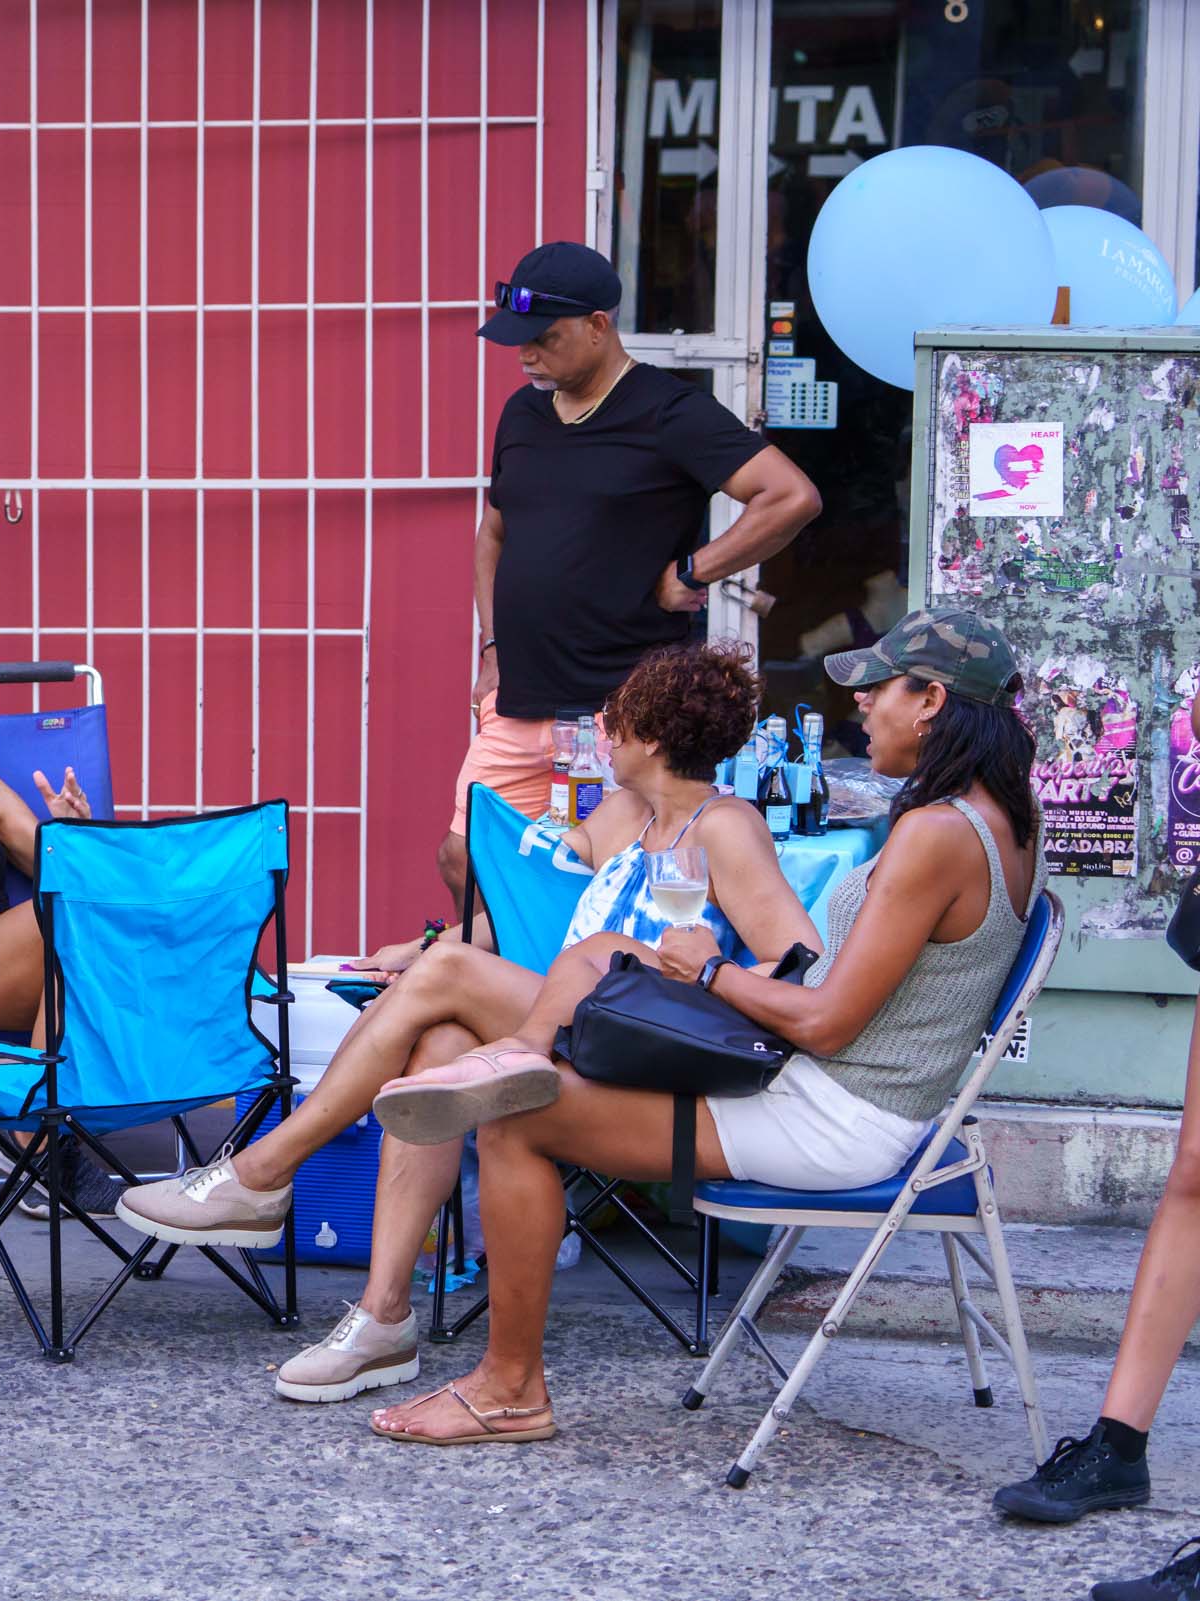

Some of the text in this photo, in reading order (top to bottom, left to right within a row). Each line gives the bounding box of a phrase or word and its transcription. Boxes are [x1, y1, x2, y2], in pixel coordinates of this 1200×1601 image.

[774, 344, 791, 352] VISA
[767, 360, 804, 368] Business
[767, 369, 792, 377] Hours
[1077, 822, 1106, 830] SOUND
